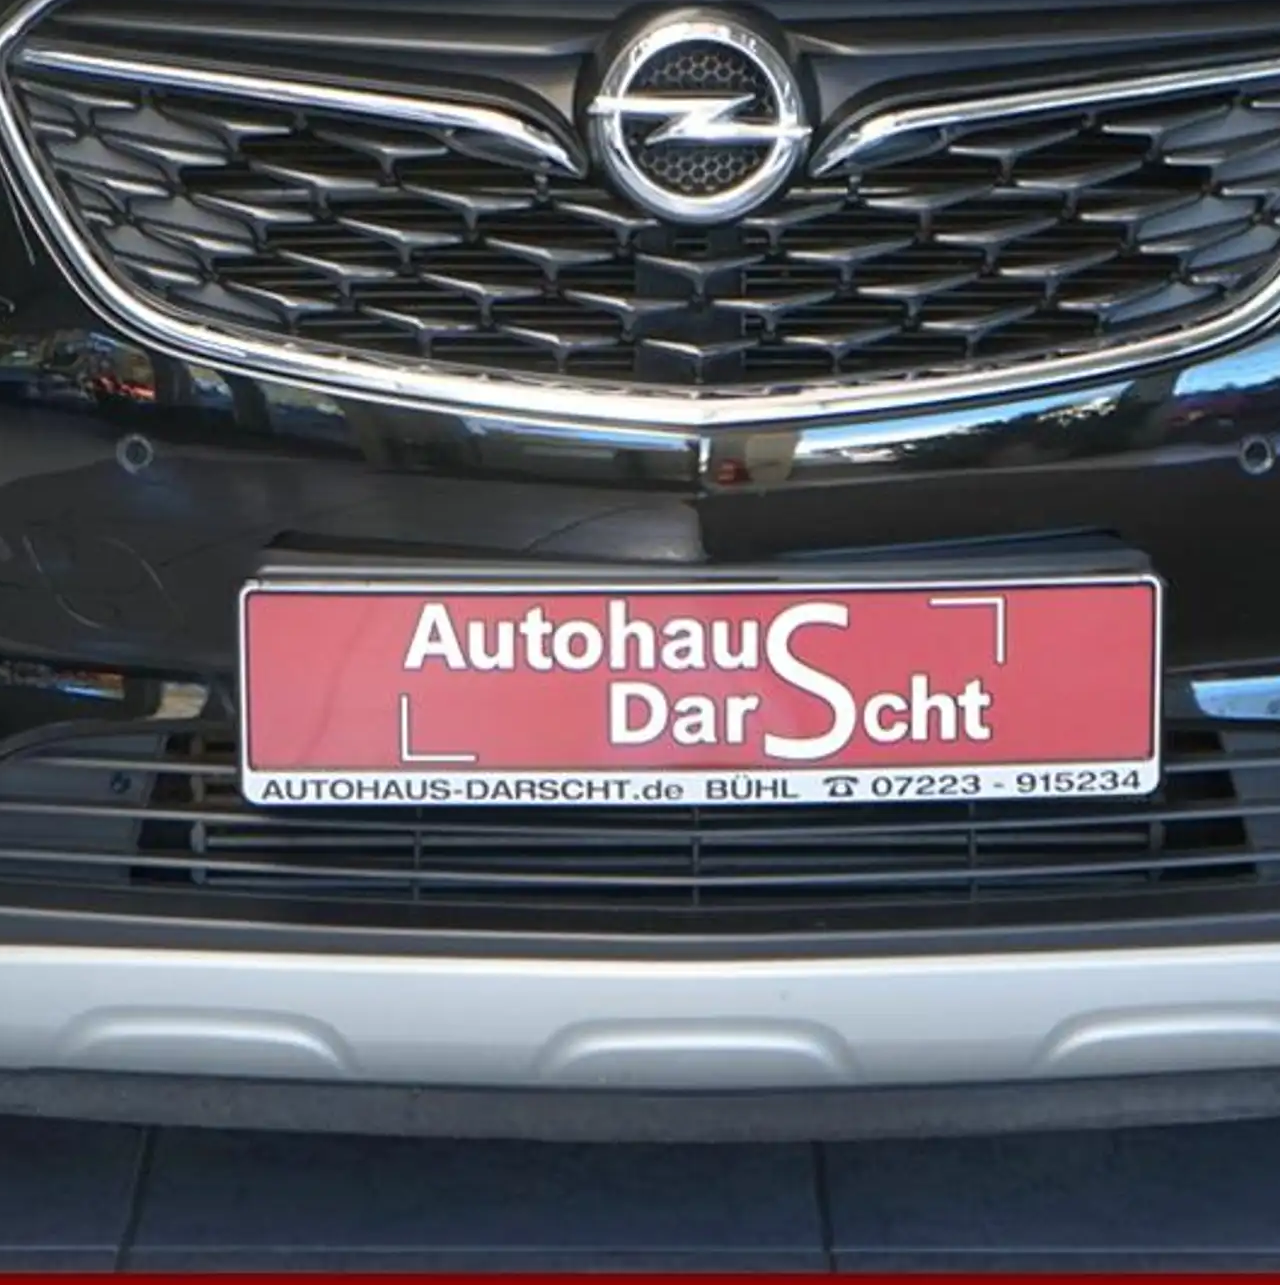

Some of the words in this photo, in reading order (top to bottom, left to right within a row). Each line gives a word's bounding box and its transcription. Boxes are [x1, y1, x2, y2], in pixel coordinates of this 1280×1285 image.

[261, 778, 685, 802] AUTOHAUS-DARSCHT.de
[705, 774, 799, 800] BÜHL
[870, 776, 982, 798] 07223
[1016, 769, 1142, 795] 915234
